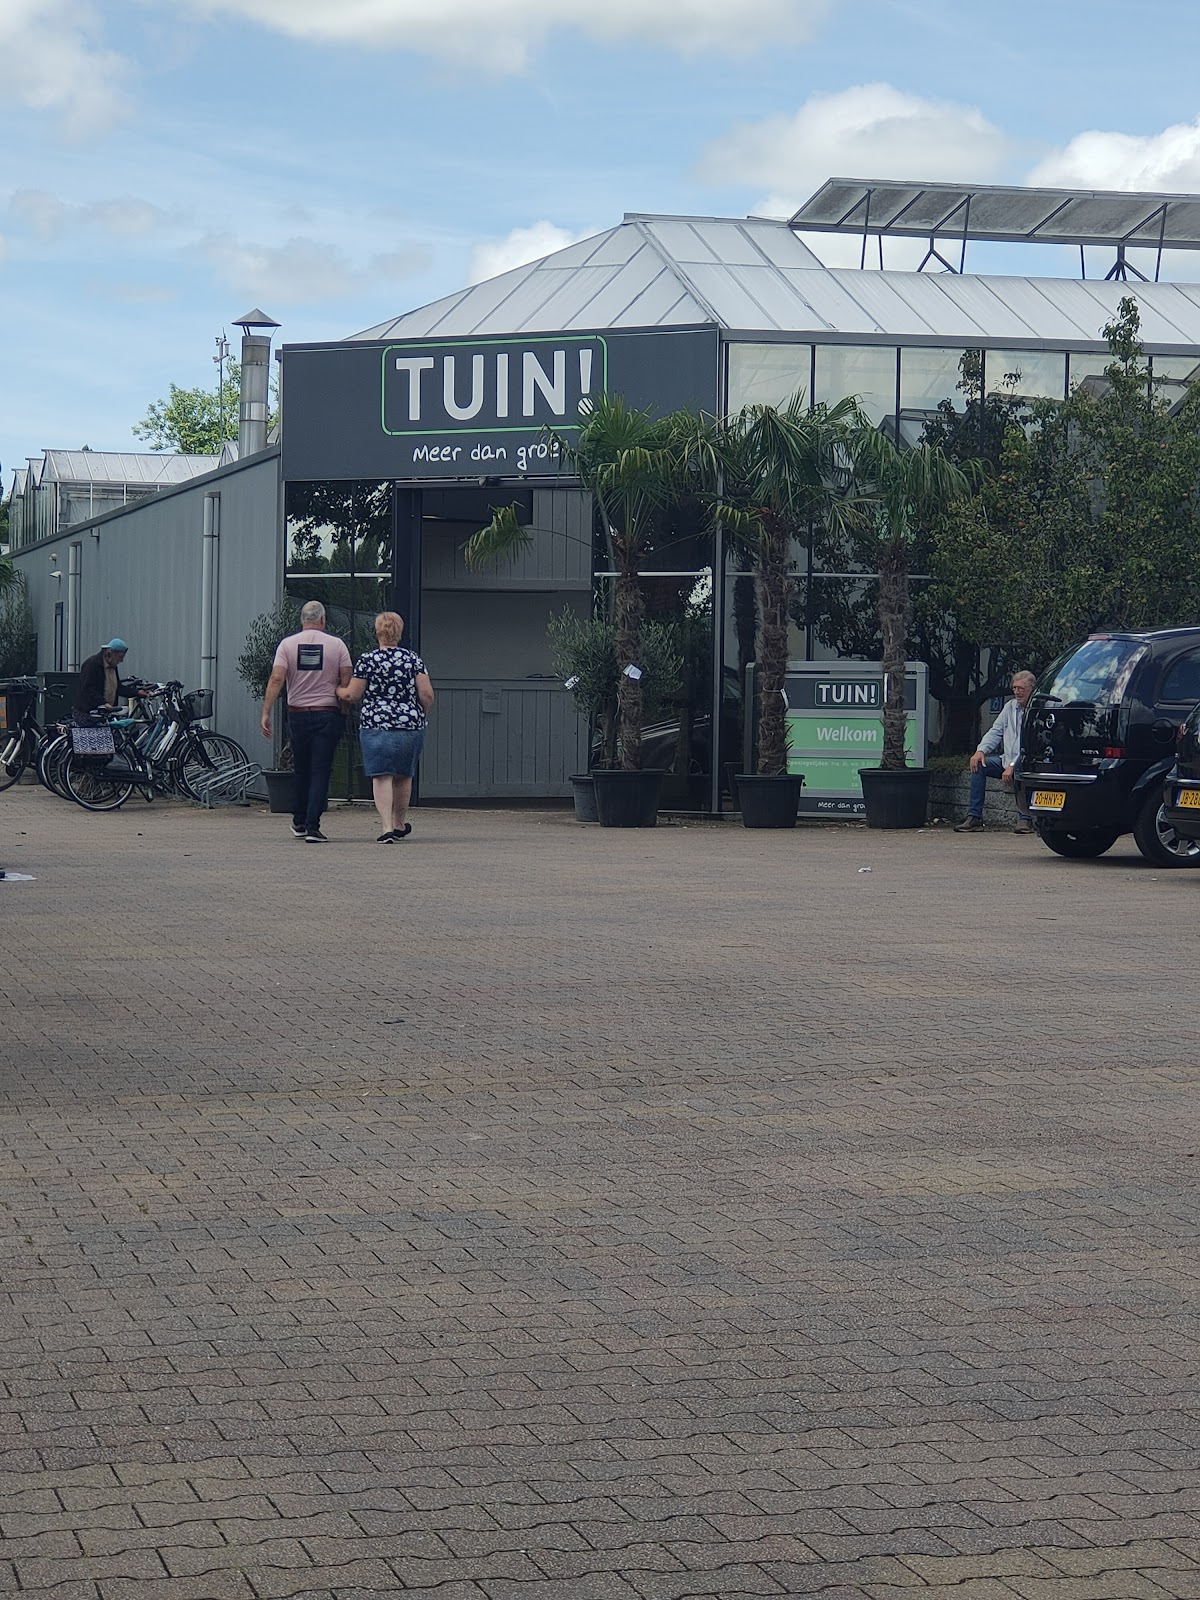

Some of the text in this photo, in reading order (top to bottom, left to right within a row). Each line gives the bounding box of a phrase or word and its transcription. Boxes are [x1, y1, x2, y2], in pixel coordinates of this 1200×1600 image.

[395, 348, 595, 421] TUIN!
[412, 441, 564, 471] Meer dan groe
[818, 684, 876, 703] TUIN!
[816, 726, 877, 742] Welkom
[853, 803, 866, 812] gro
